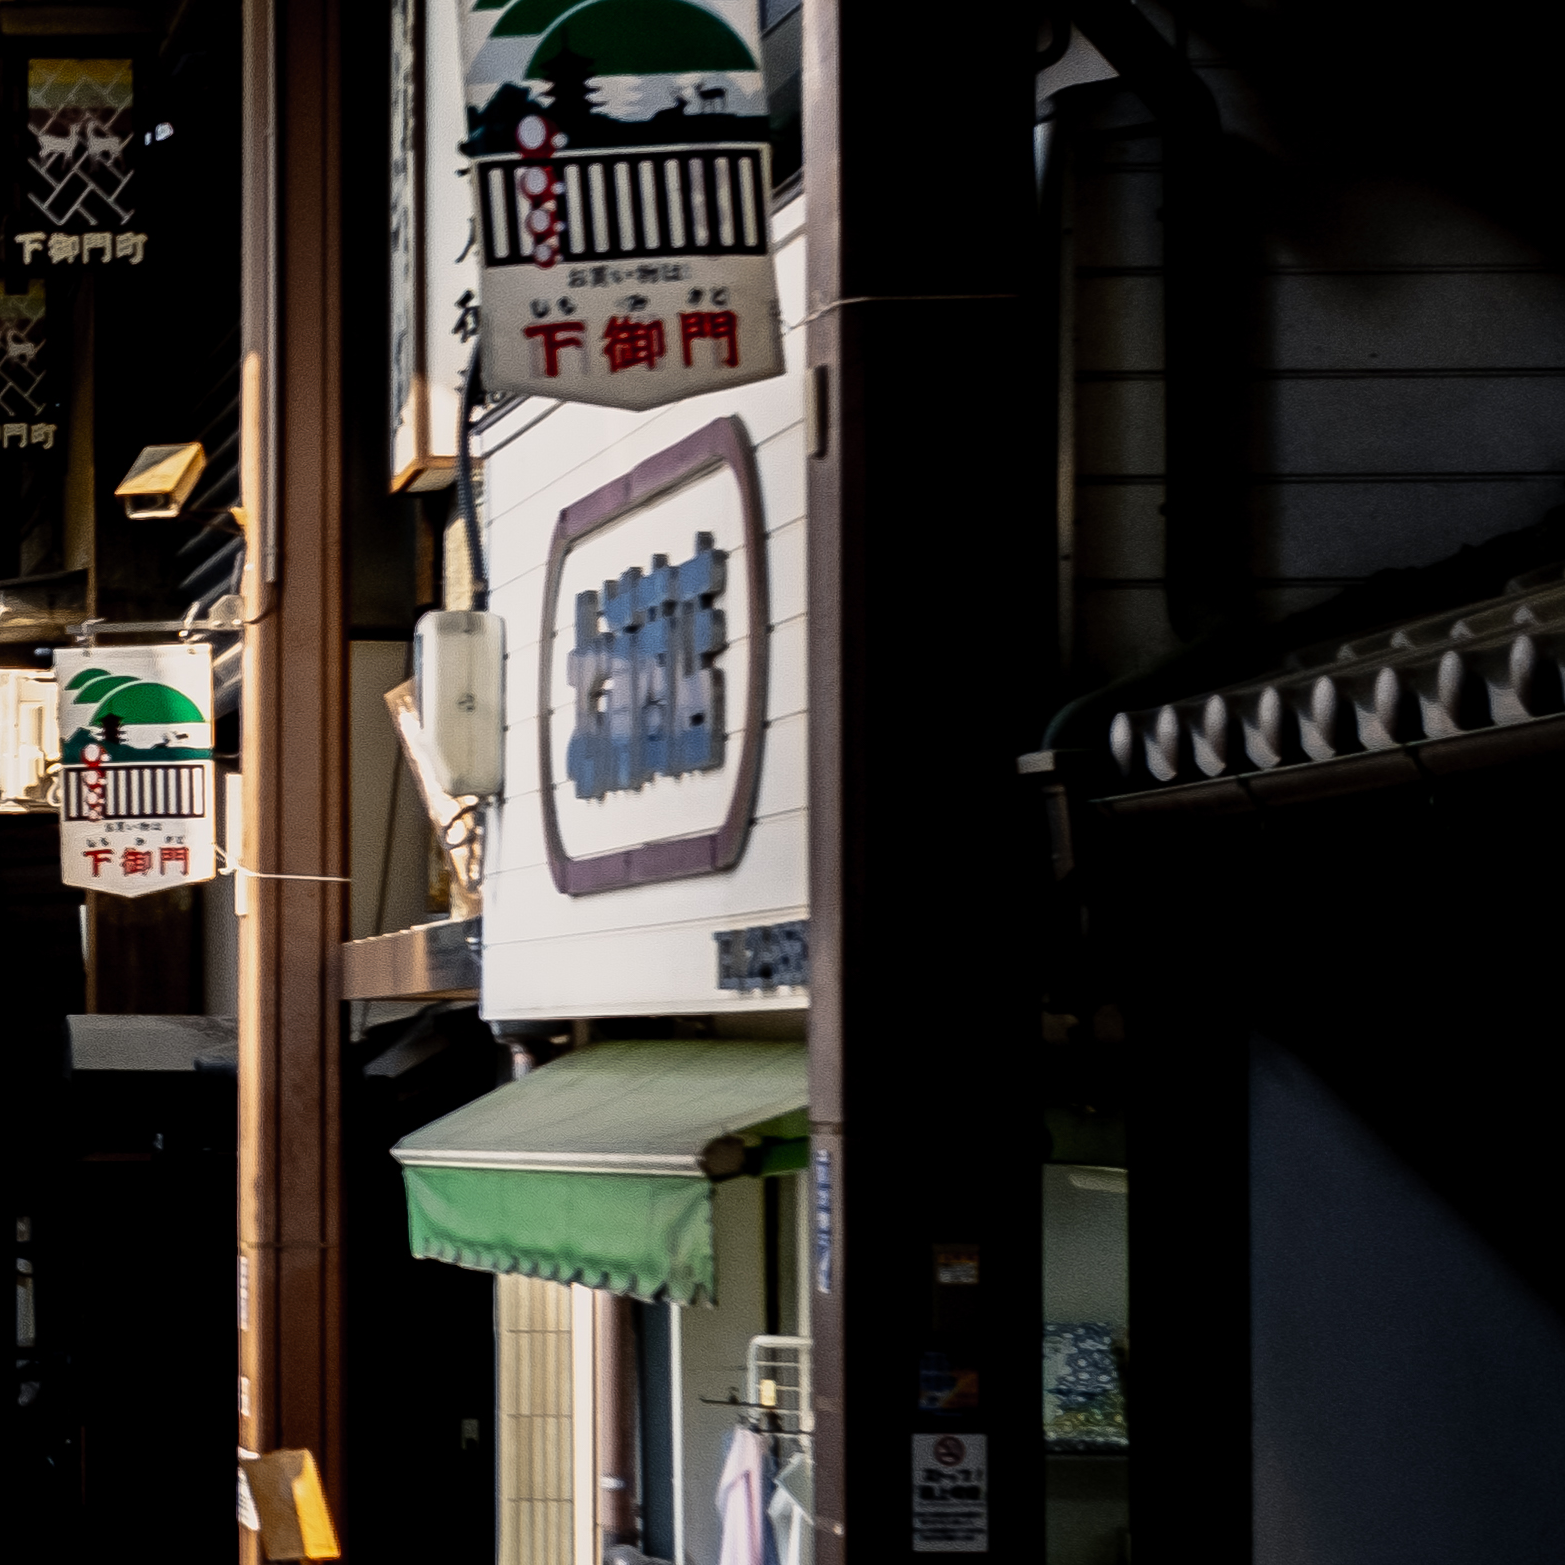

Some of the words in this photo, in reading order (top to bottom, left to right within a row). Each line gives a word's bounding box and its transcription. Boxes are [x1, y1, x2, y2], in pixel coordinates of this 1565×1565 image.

[14, 231, 148, 265] 下御門町
[523, 309, 740, 378] 下御門
[83, 846, 189, 877] 下御門
